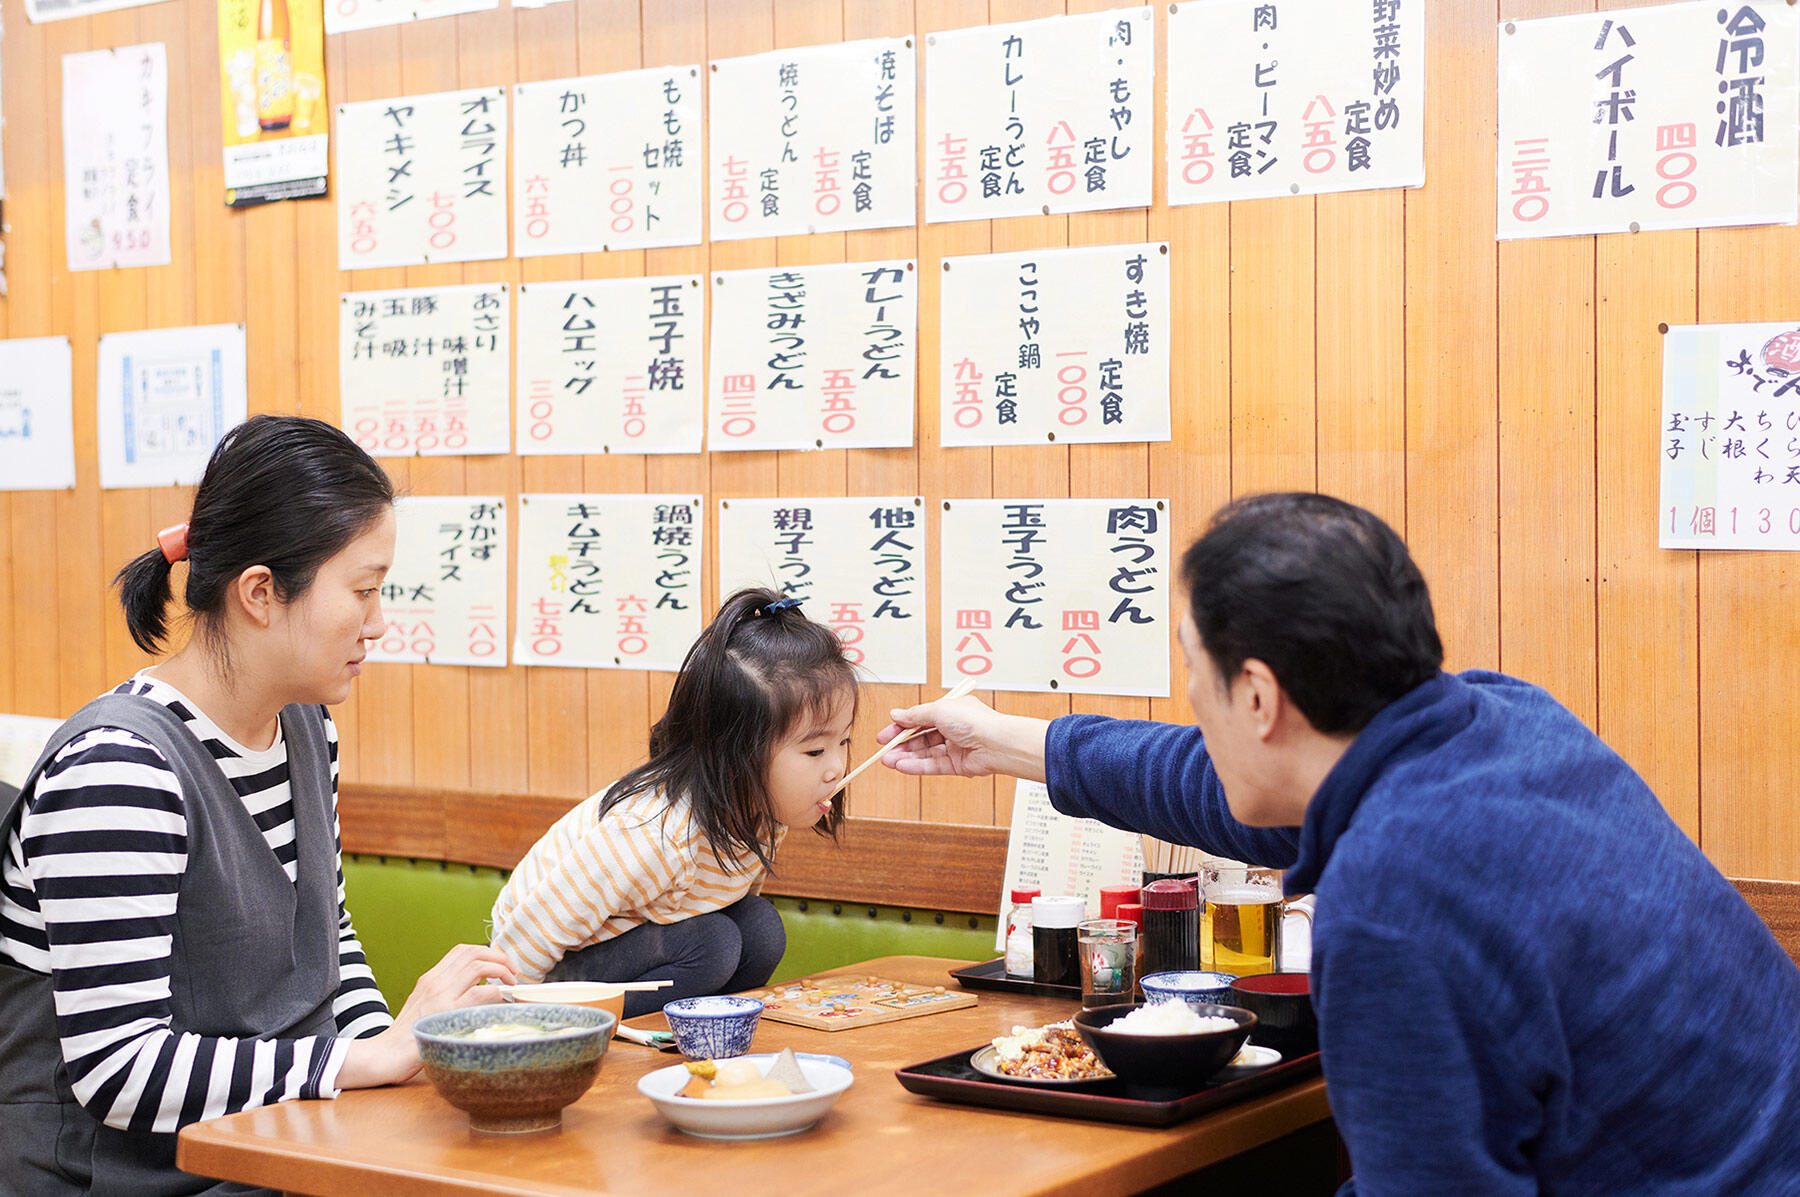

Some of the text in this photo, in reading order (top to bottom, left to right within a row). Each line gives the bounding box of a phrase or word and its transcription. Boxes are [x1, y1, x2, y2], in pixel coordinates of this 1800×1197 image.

[874, 50, 896, 144] 焼そば
[1373, 0, 1401, 130] 野菜炒め
[1715, 5, 1766, 147] 冷酒
[461, 96, 496, 198] オムライス
[560, 90, 588, 168] かつ丼
[663, 78, 683, 168] もも焼
[1002, 35, 1026, 195] カレーうどん
[1344, 100, 1371, 172] 定食
[1592, 20, 1636, 199] ハイボール
[384, 106, 415, 211] ヤキメシ
[643, 143, 660, 231] セット
[851, 149, 872, 213] 定食
[980, 145, 1002, 199] 定食
[1084, 137, 1107, 193] 定食
[1227, 122, 1252, 178] 定食
[760, 168, 779, 218] 定食
[353, 301, 378, 359] みそ汁
[411, 296, 438, 356] 豚汁
[473, 293, 500, 352] あさり
[648, 285, 684, 392] 玉子焼
[766, 272, 807, 390] きざみうどん
[861, 268, 904, 380] カレーうどん
[1018, 263, 1040, 369] ここや鍋
[1124, 254, 1149, 355] すき焼
[442, 336, 468, 398] 味噌汁
[562, 293, 597, 395] ハムエッグ
[995, 372, 1018, 425] 定食
[1099, 358, 1123, 425] 定食
[1665, 413, 1689, 460] 玉子
[1694, 411, 1716, 460] すじ
[1722, 410, 1747, 459] 大根
[1754, 410, 1774, 484] ちくわ
[440, 524, 464, 581] ライス
[470, 503, 498, 562] おかず
[652, 504, 693, 610] 鍋焼うどん
[773, 507, 814, 601] 親子うど
[869, 507, 915, 619] 他人うどん
[1002, 504, 1047, 629] 玉子うどん
[1106, 505, 1160, 625] 肉うどん
[381, 583, 404, 602] 中
[409, 584, 434, 602] 大
